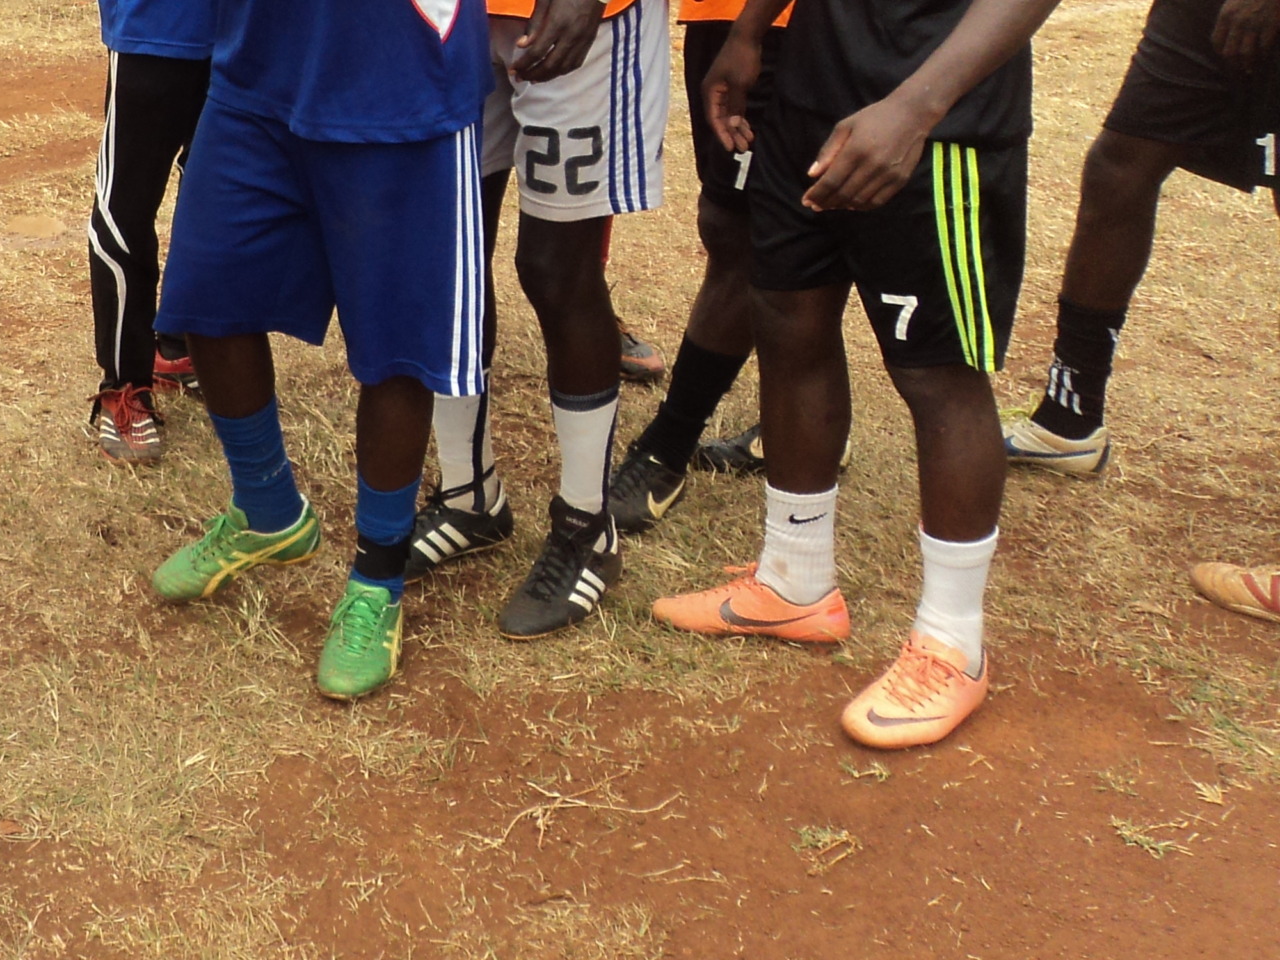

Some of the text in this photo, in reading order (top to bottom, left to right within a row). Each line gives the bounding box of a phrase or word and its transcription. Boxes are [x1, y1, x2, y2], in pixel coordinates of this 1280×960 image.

[522, 125, 603, 195] 22
[733, 150, 753, 191] 1
[1256, 133, 1275, 176] 1
[881, 293, 918, 340] 7
